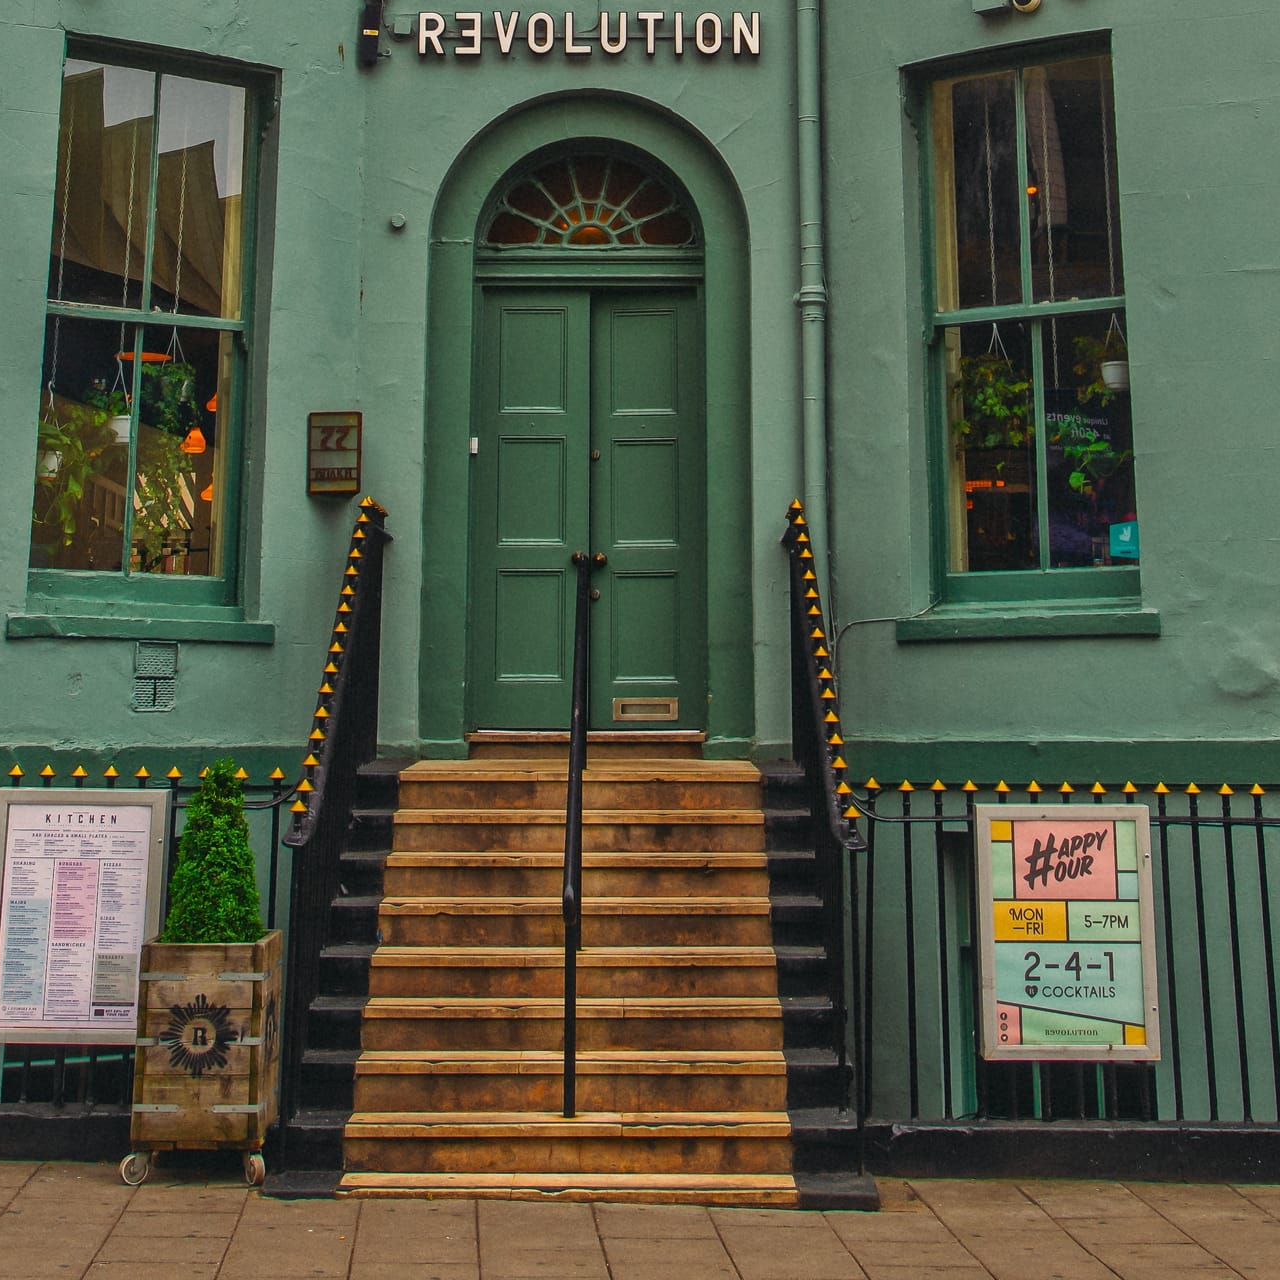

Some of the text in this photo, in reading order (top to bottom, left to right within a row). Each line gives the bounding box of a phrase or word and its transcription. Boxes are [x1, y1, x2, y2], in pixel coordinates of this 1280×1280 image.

[417, 11, 761, 55] REVOLUTION
[45, 813, 118, 825] KITCHEN
[1009, 908, 1044, 921] MON
[1042, 986, 1116, 998] COCKTAILS
[192, 1027, 208, 1046] R
